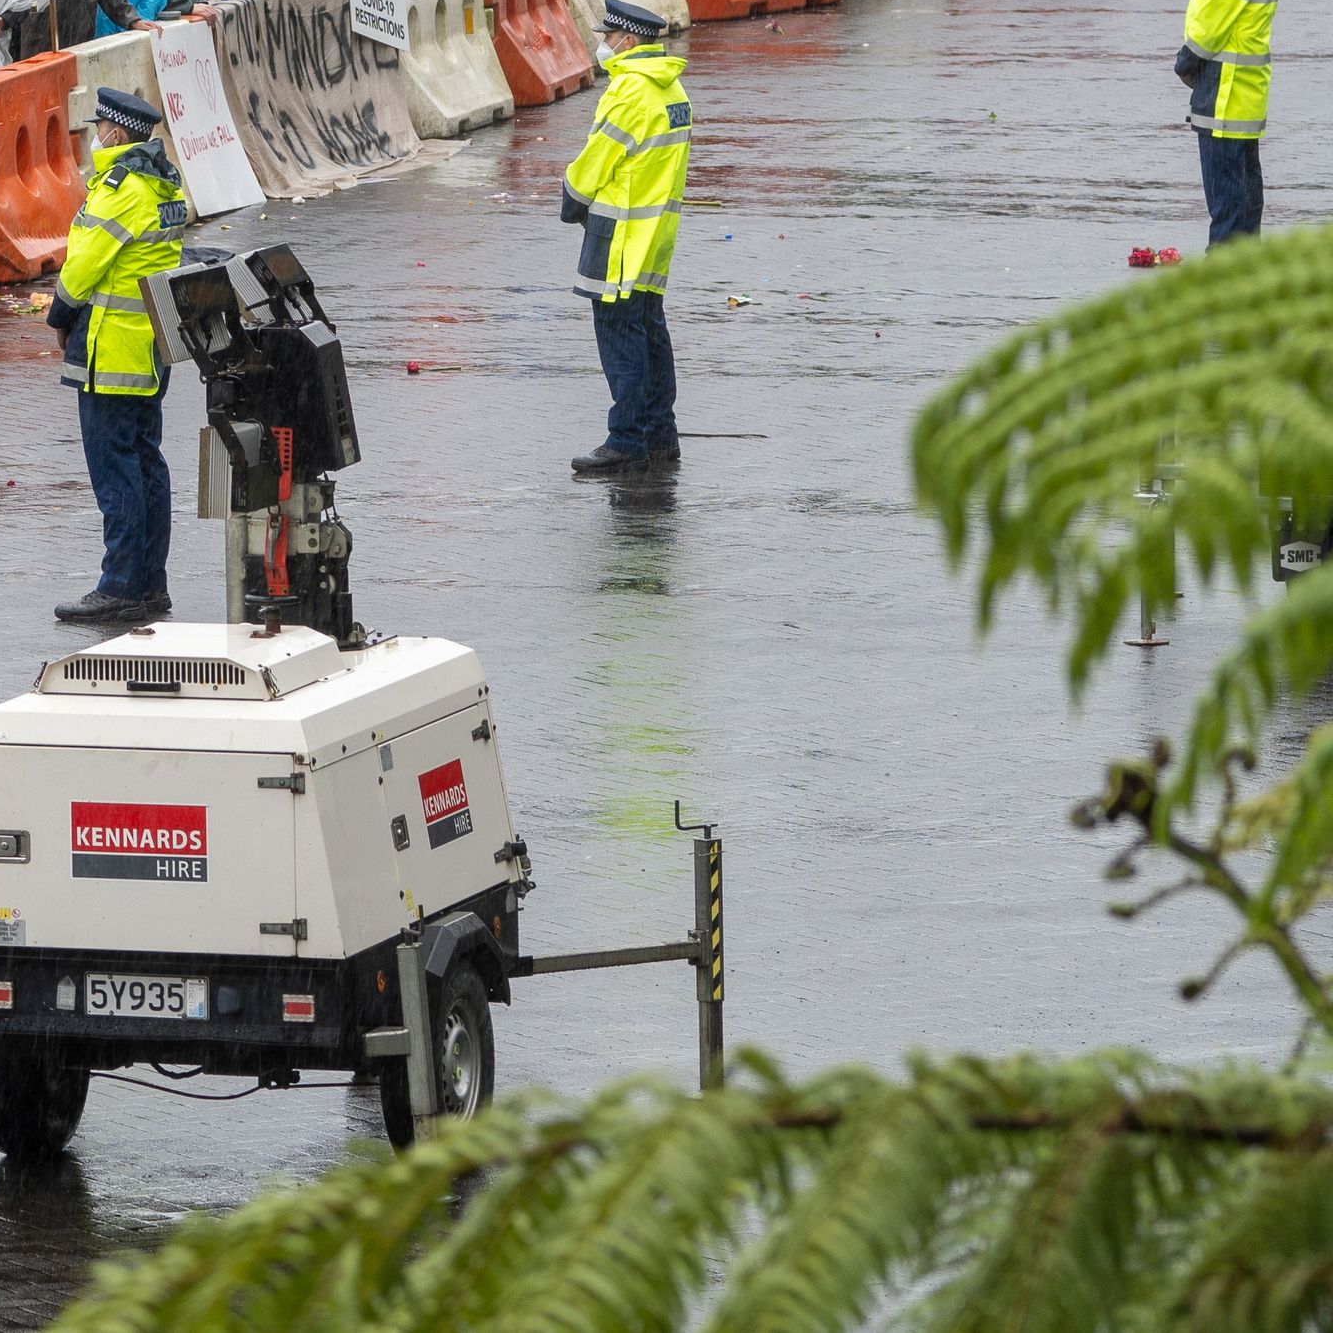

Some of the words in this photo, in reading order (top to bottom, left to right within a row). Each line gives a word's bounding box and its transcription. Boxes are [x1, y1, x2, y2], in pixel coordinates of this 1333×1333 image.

[355, 7, 405, 40] RESTRICTIONS
[159, 49, 188, 72] JACINDA
[423, 782, 467, 818] KENNARDS
[454, 812, 471, 835] HIRE
[76, 826, 202, 851] KENNARDS
[156, 859, 202, 879] HIRE
[91, 979, 183, 1013] 5Y935
